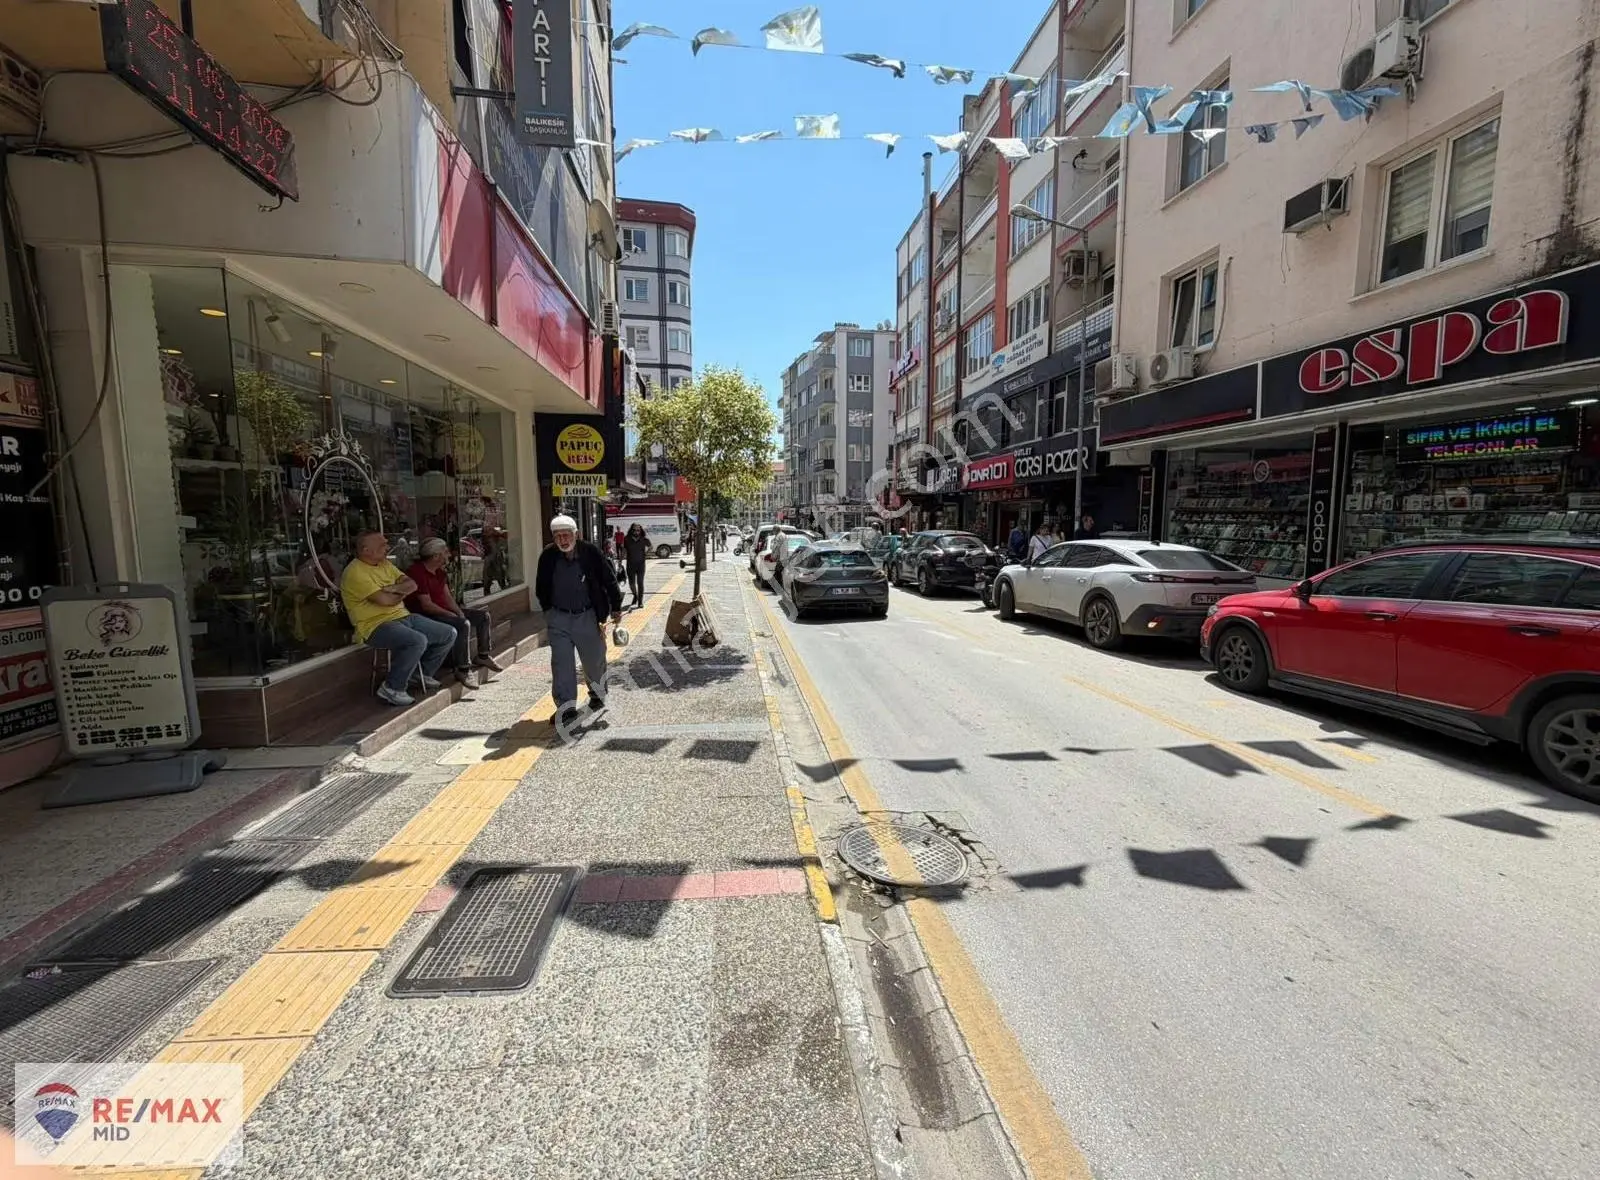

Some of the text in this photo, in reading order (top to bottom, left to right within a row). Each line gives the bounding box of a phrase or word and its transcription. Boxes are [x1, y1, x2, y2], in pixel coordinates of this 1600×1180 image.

[532, 0, 551, 106] ARTİ
[1299, 289, 1570, 394] espa
[1406, 430, 1445, 444] SIFIR
[1449, 426, 1473, 440] VE
[1535, 416, 1561, 432] EL
[1424, 437, 1540, 458] TELEFONLAR
[555, 475, 603, 485] KAMPANYA
[1312, 500, 1326, 553] oppo
[109, 645, 170, 659] Güzellik
